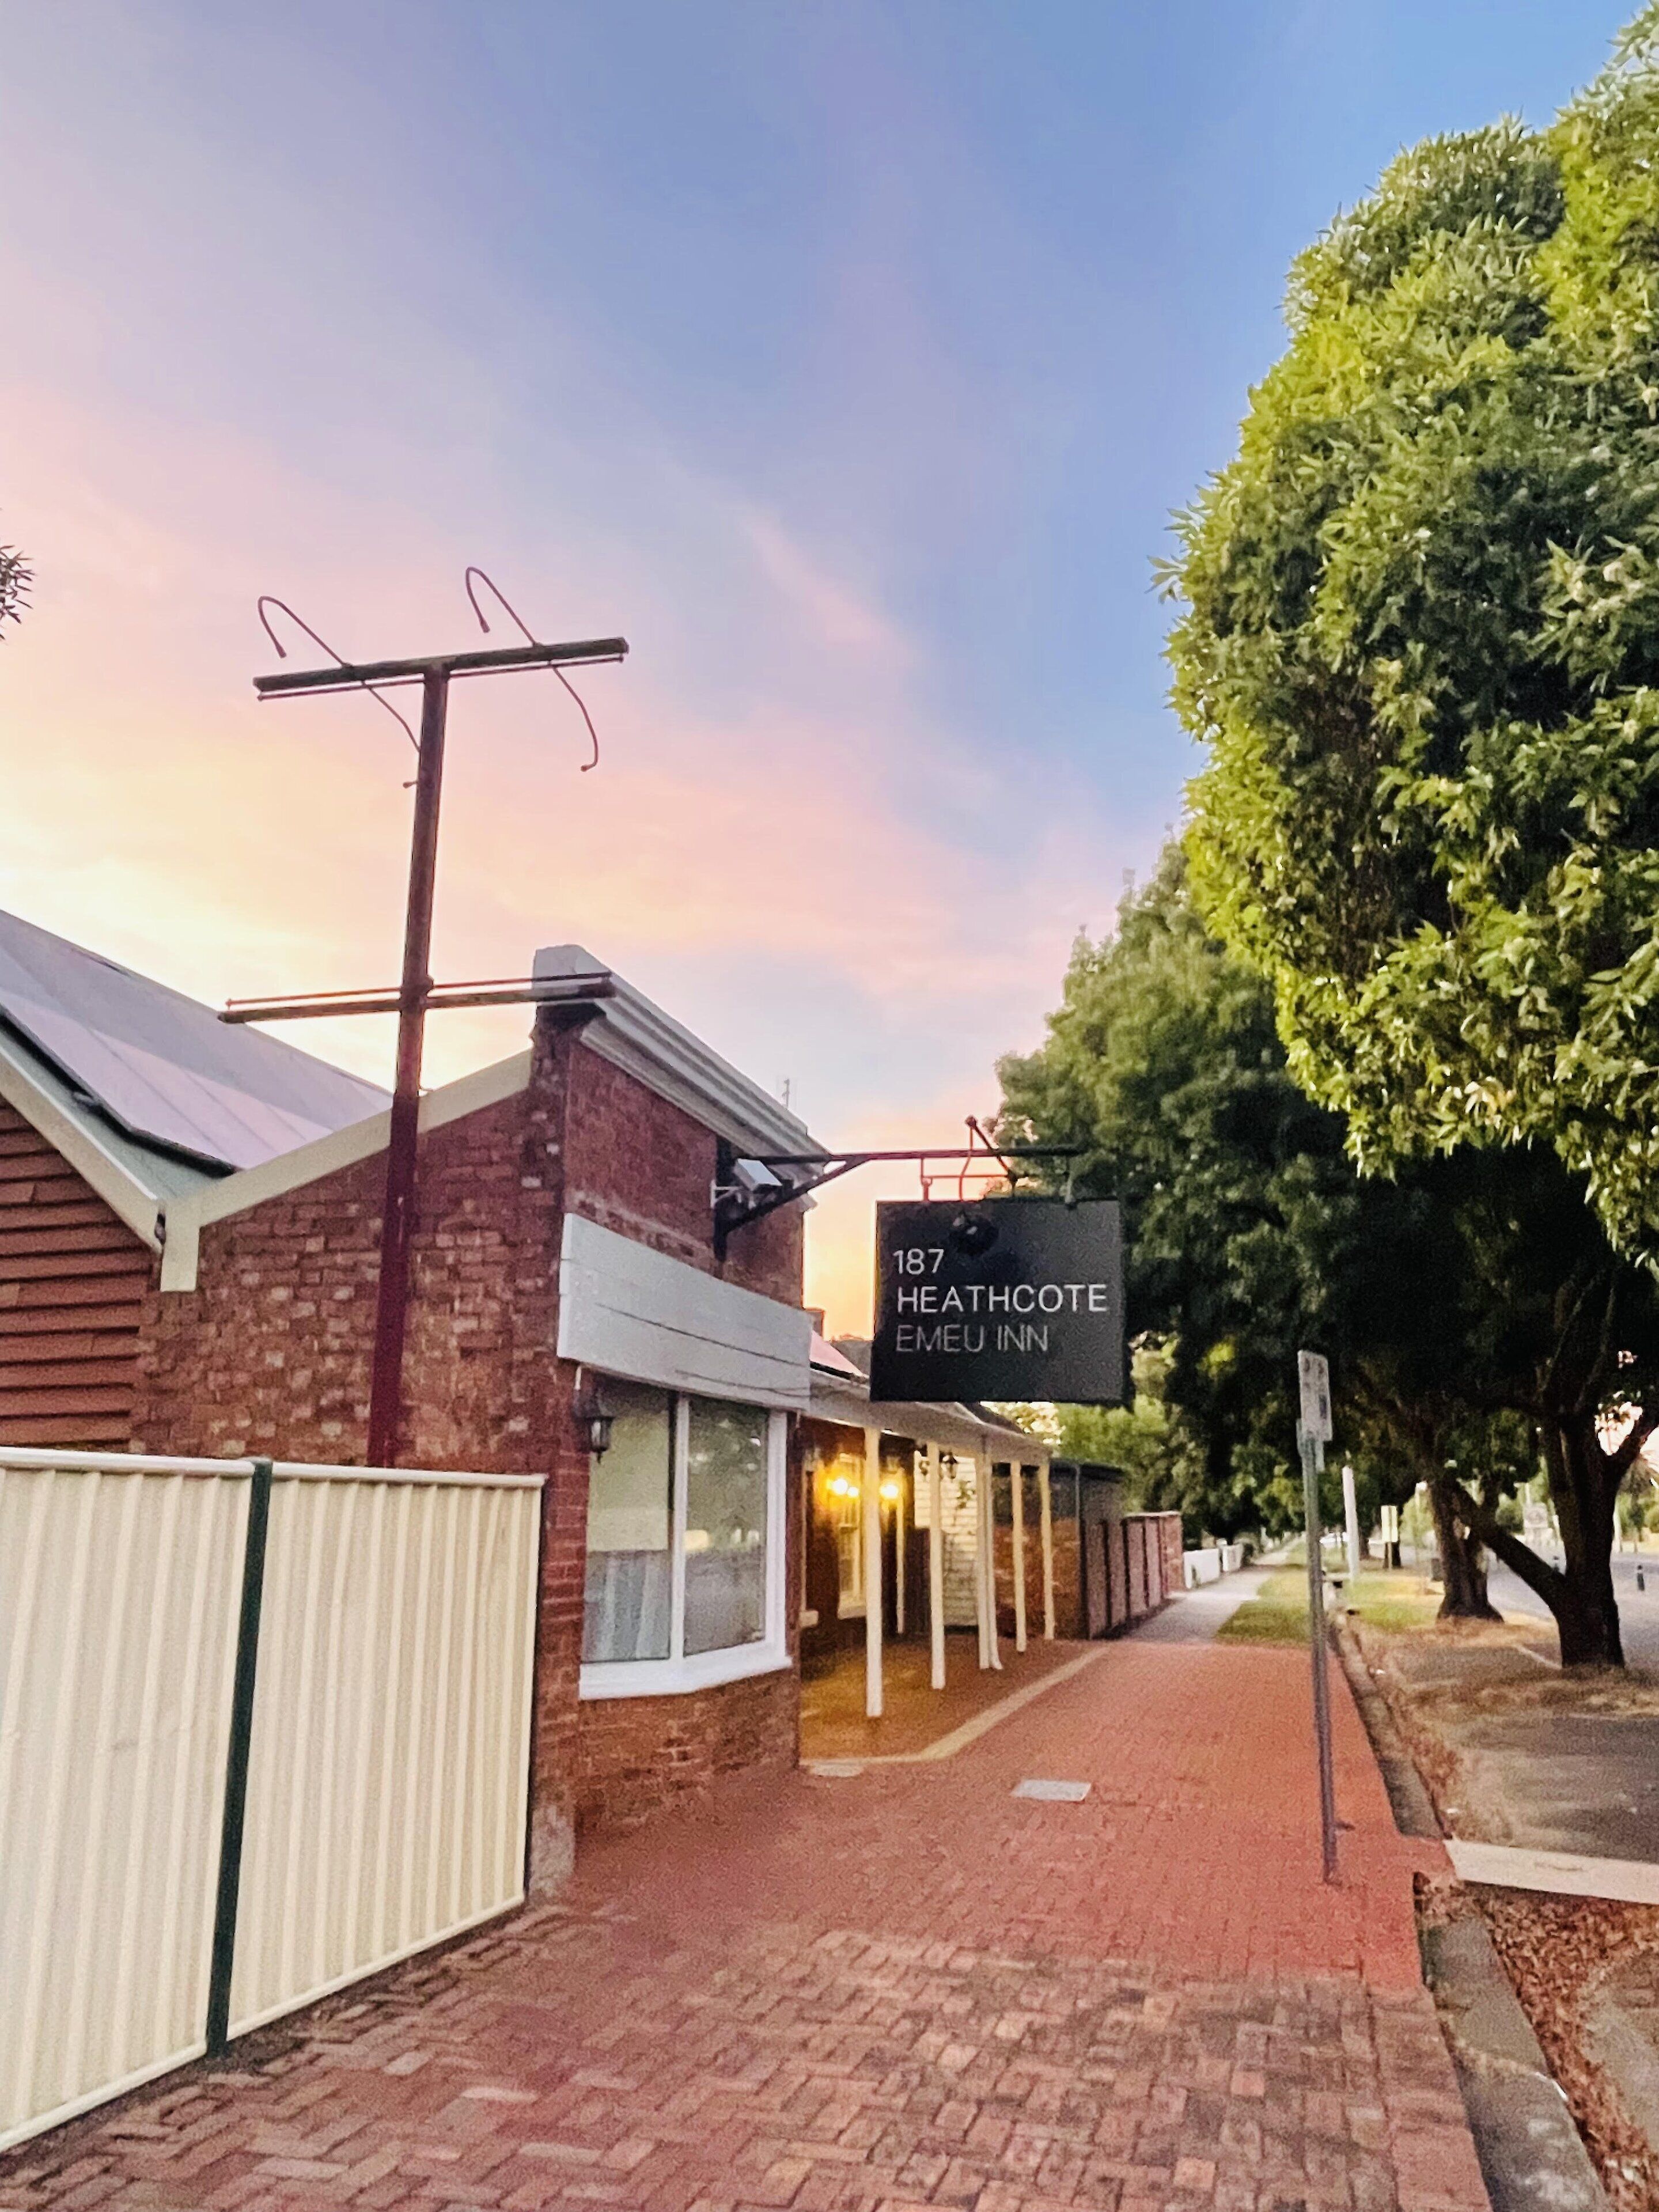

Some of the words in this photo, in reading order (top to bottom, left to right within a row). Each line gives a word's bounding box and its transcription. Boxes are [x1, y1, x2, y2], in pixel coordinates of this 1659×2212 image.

[893, 1248, 944, 1274] 187
[897, 1284, 1107, 1313] HEATHCOTE
[896, 1325, 983, 1352] EMEU
[998, 1325, 1048, 1351] INN
